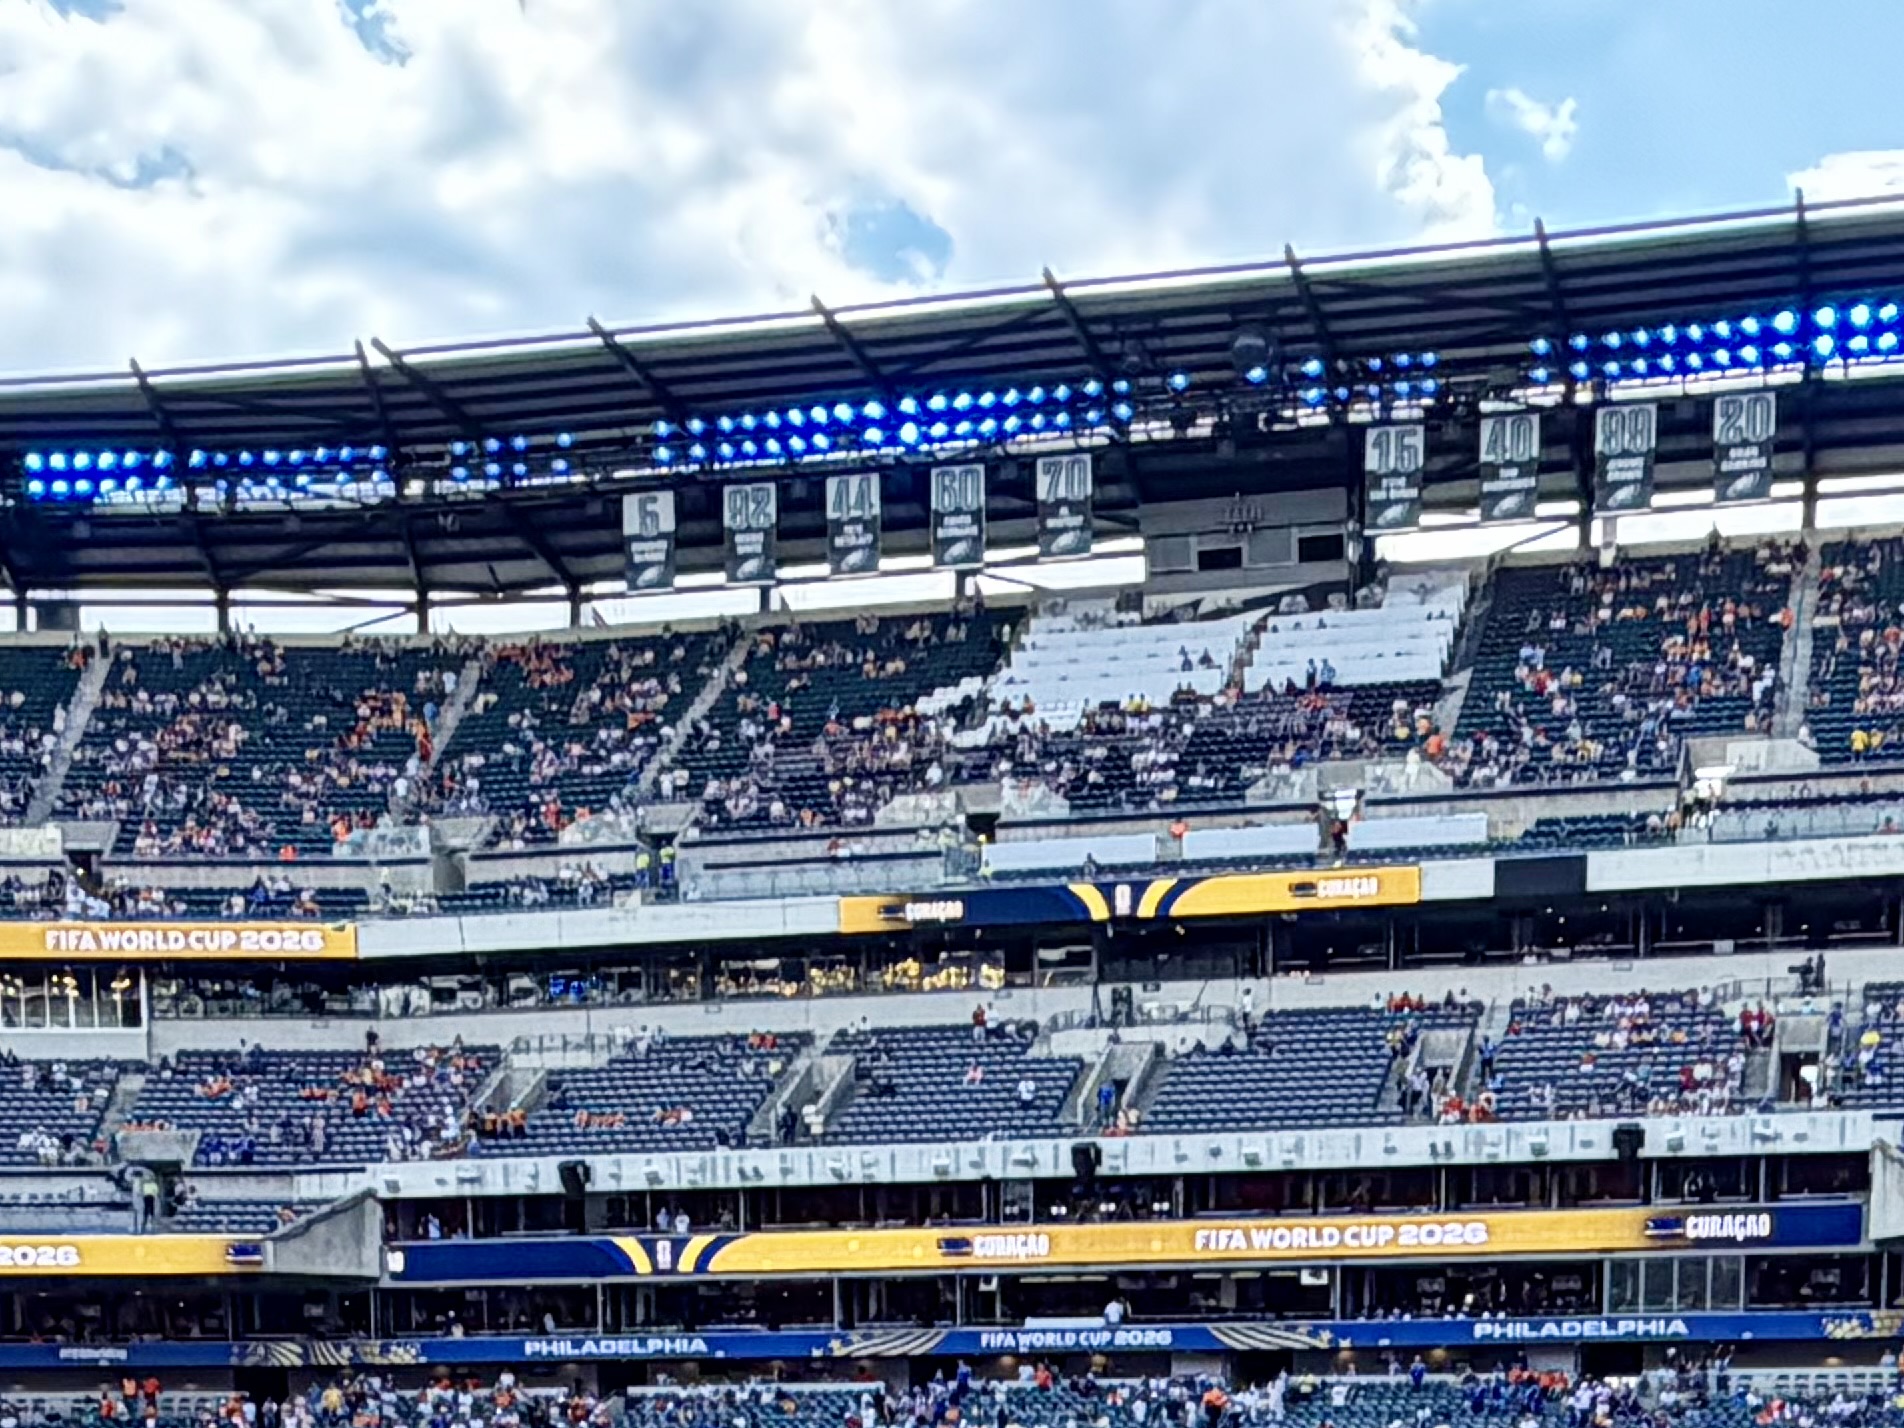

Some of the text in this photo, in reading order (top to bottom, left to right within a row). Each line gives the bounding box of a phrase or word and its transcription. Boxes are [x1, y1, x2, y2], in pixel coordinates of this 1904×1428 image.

[1719, 394, 1773, 445] 20
[1483, 415, 1535, 463] 40
[1042, 457, 1088, 504] 70
[832, 475, 874, 522] 44
[45, 929, 325, 952] FIFA WORLD CUP 2026
[1195, 1221, 1488, 1251] FIFA WORLD CUP 2026
[1686, 1213, 1771, 1241] CURAÇAO
[981, 1330, 1172, 1348] FIFA WORLD CUP 2026
[1473, 1318, 1690, 1339] PHILADELPHIA
[524, 1338, 708, 1356] PHILADELPHIA
